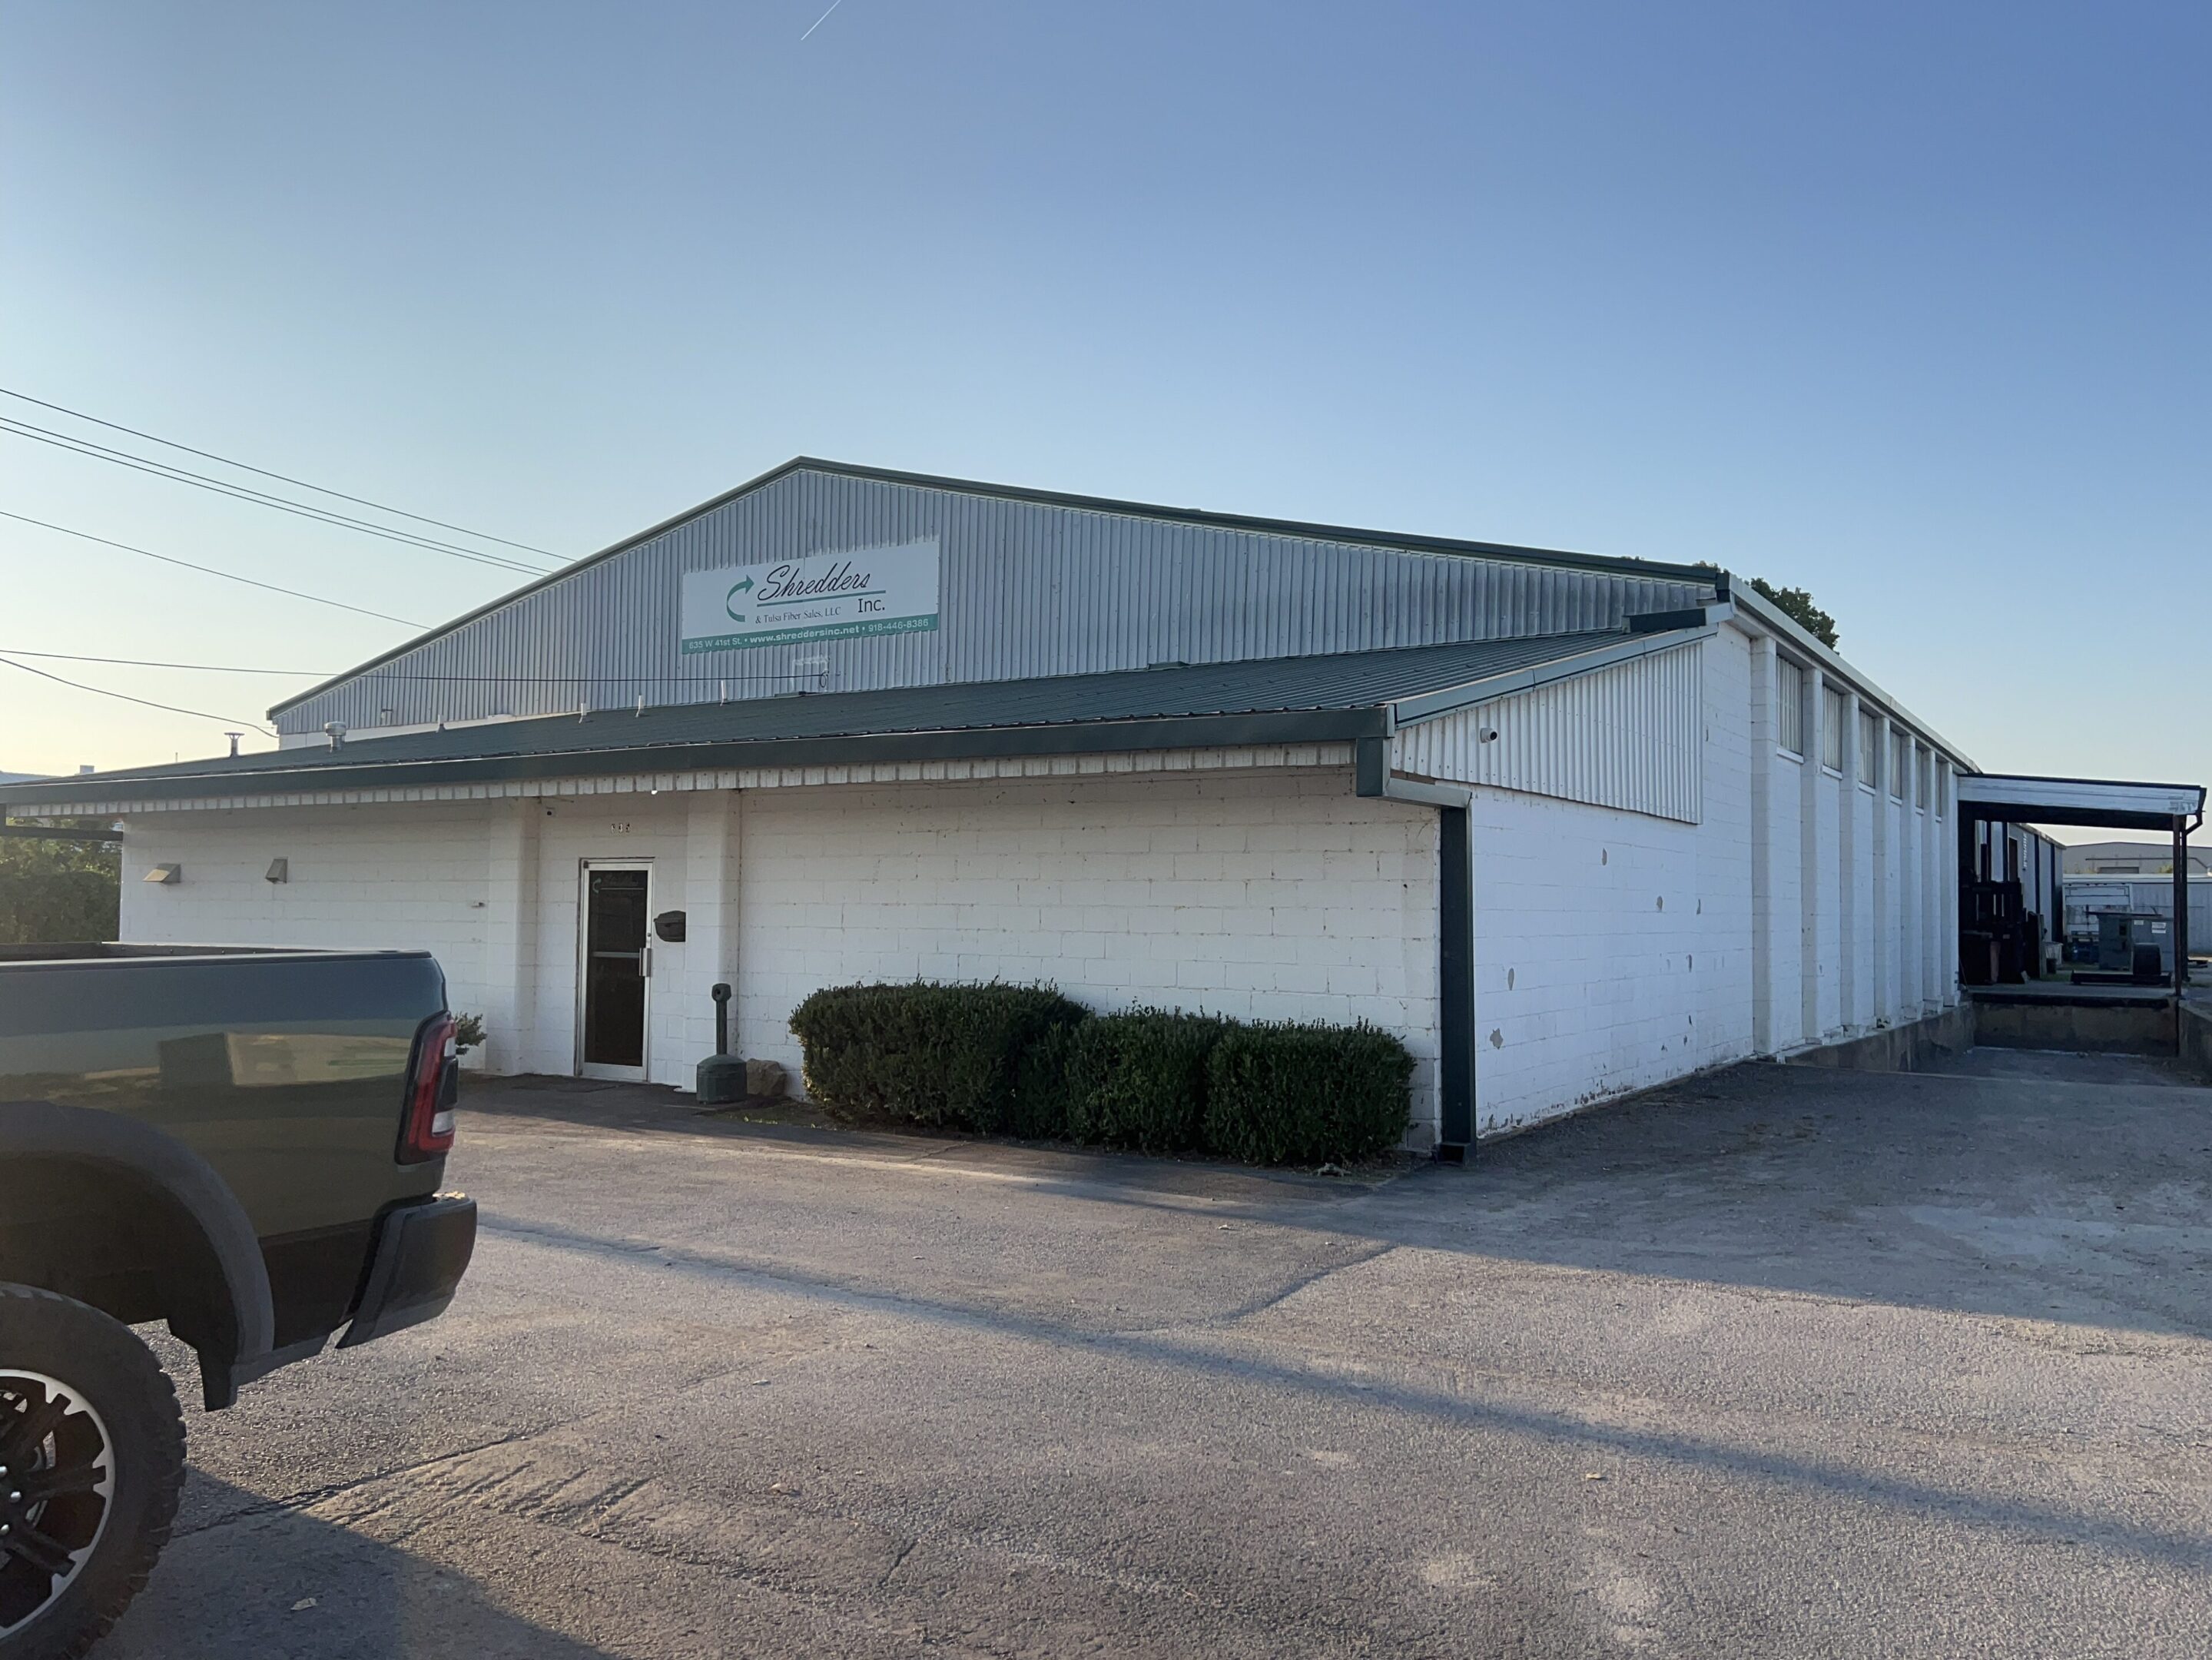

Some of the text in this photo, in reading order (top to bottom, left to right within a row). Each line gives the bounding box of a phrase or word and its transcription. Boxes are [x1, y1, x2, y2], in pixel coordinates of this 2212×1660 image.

[757, 561, 871, 601] Shredders
[755, 616, 761, 624] &
[763, 615, 781, 623] Tulsa
[783, 612, 801, 621] Fiber
[825, 606, 841, 617] LLC
[857, 598, 885, 613] Inc.
[750, 625, 860, 643] www.shreddersinc.net
[868, 619, 929, 632] 918-446-8386
